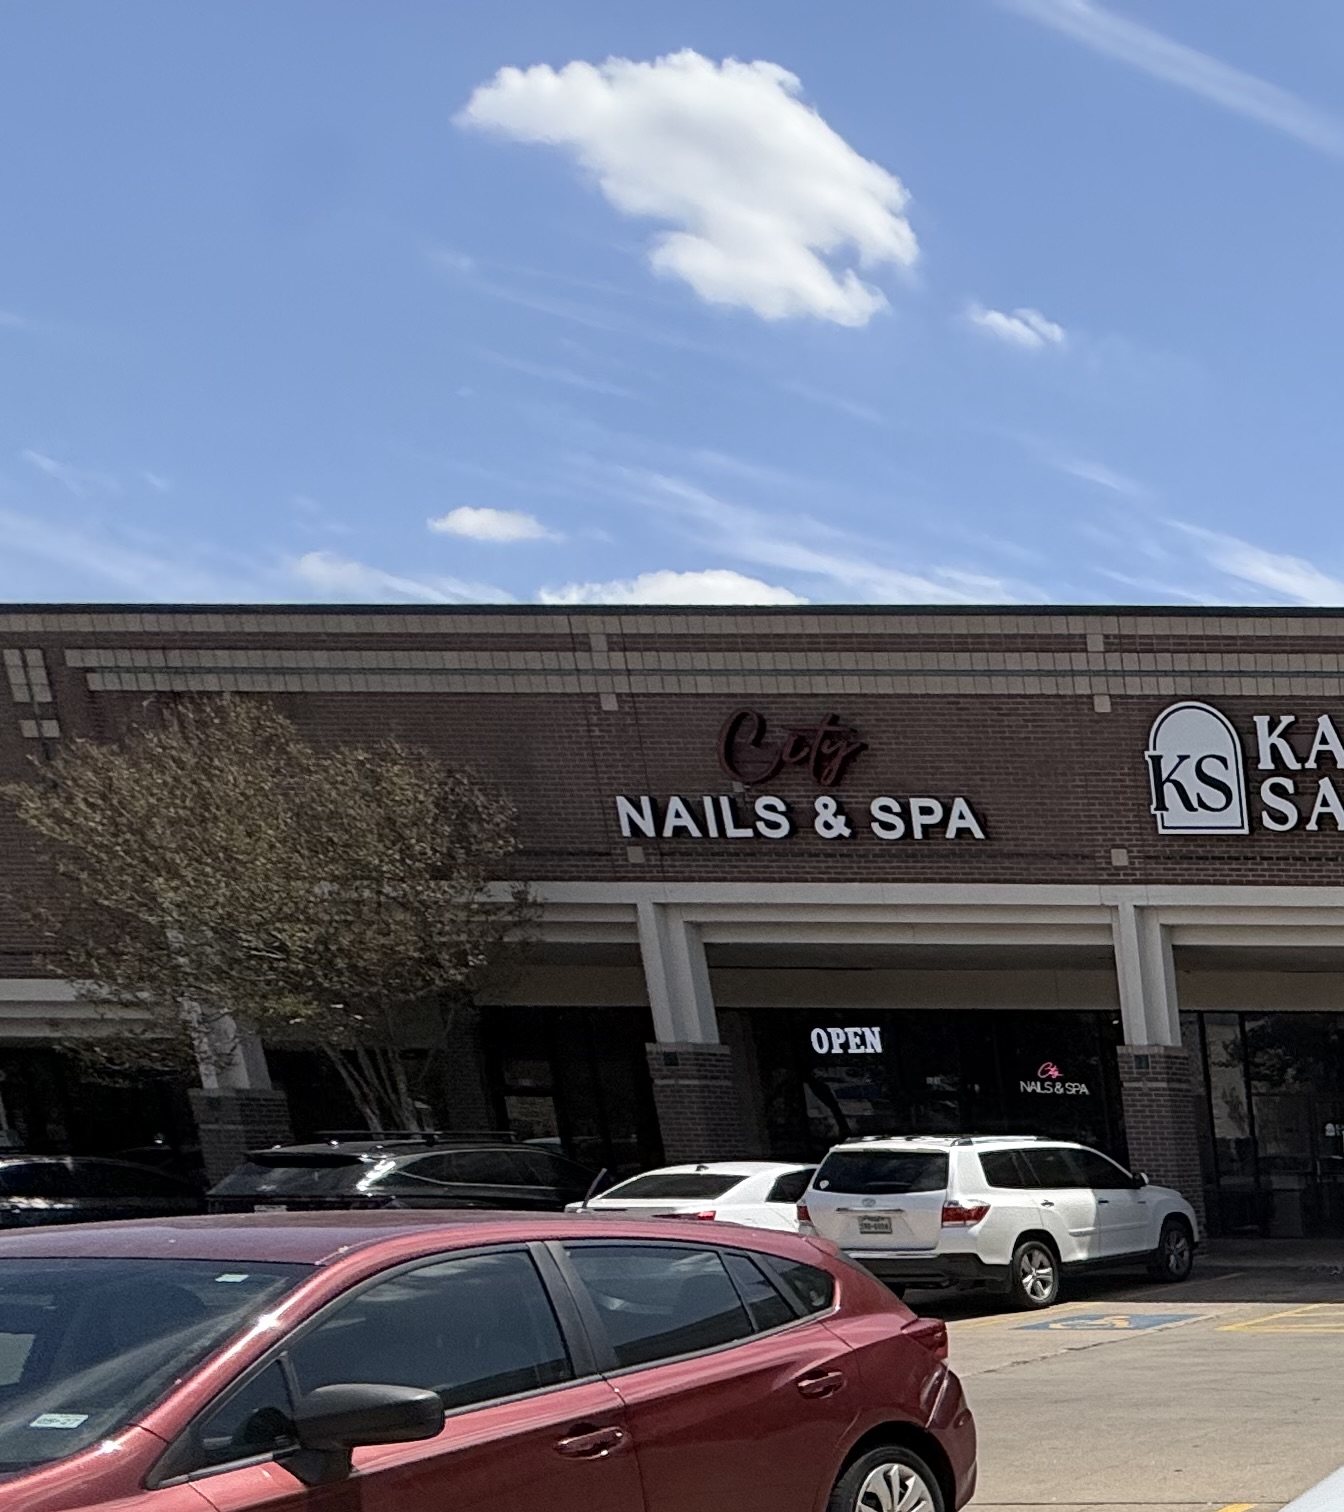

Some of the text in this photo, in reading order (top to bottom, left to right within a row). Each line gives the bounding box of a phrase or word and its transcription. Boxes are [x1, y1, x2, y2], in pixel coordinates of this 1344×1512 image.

[717, 707, 868, 786] City
[1149, 754, 1233, 812] KS
[615, 795, 985, 839] NAILS & SPA
[810, 1026, 883, 1055] OPEN
[1019, 1080, 1090, 1096] NAILS & SPA
